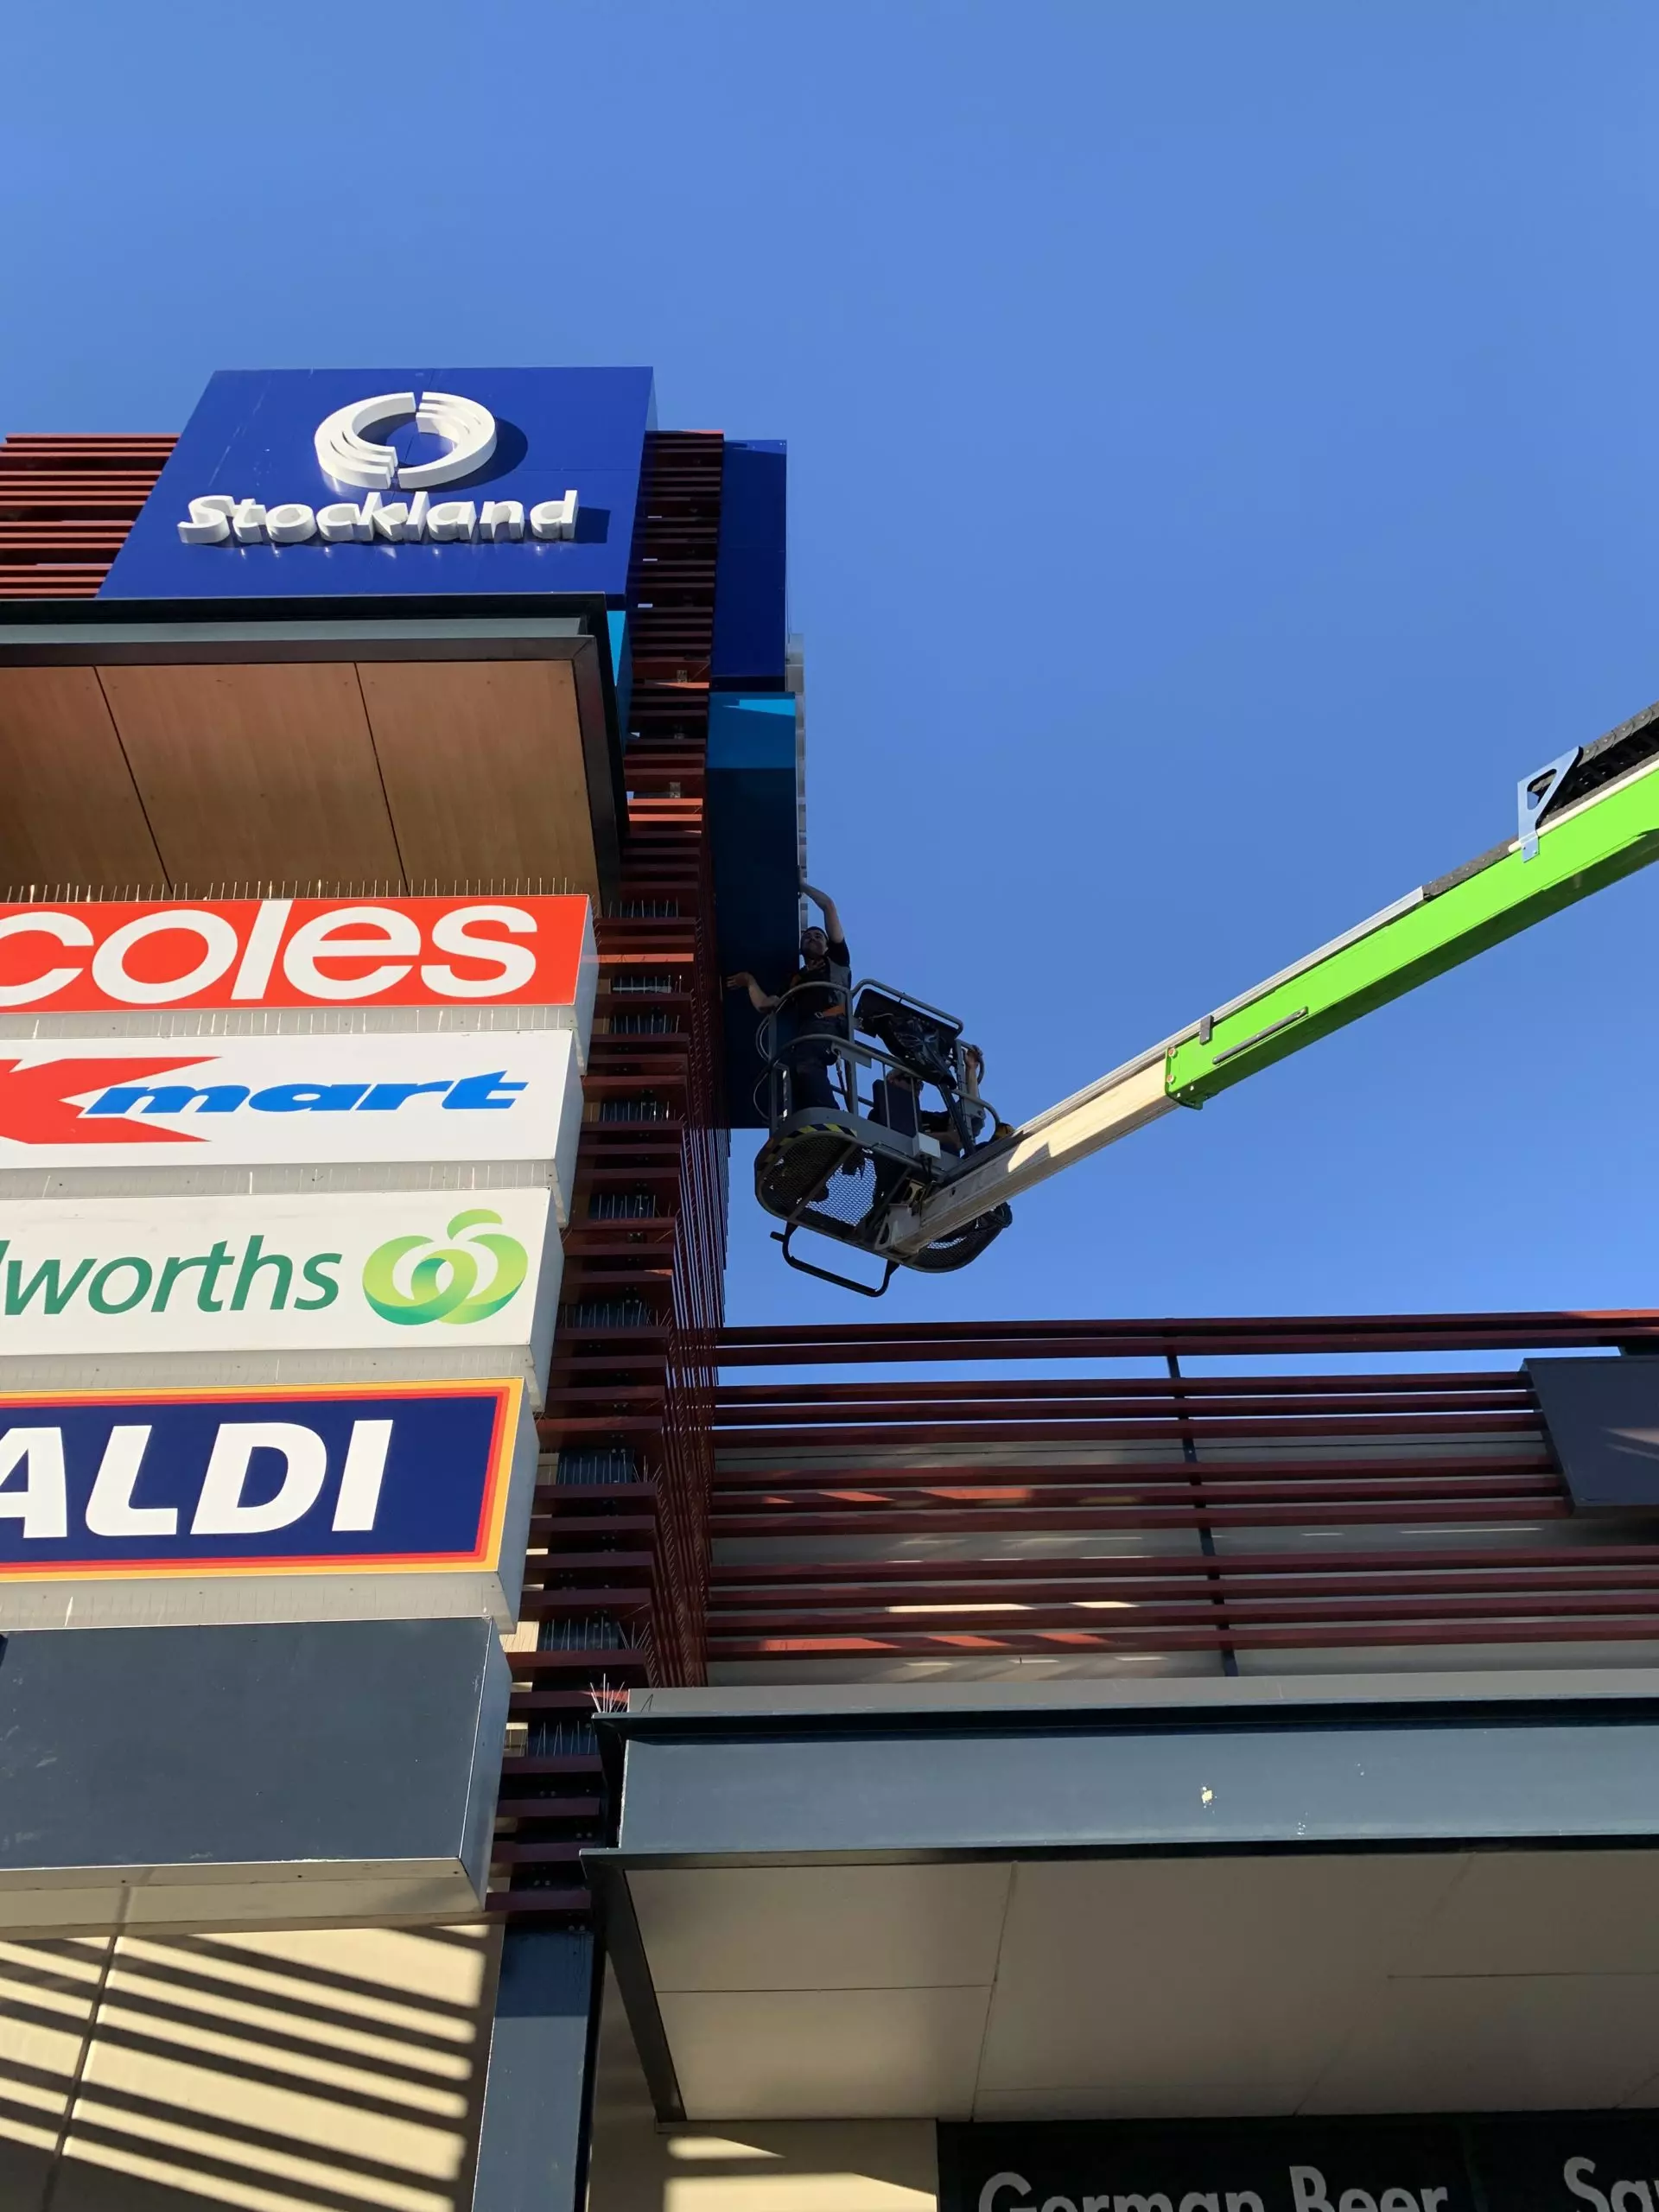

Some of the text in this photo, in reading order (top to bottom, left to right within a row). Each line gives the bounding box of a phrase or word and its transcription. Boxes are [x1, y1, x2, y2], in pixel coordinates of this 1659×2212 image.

[177, 490, 577, 543] Stockland
[0, 899, 537, 1007] coles
[0, 1235, 343, 1316] worths
[0, 1419, 394, 1539] ALDI
[1563, 2156, 1659, 2212] Sa
